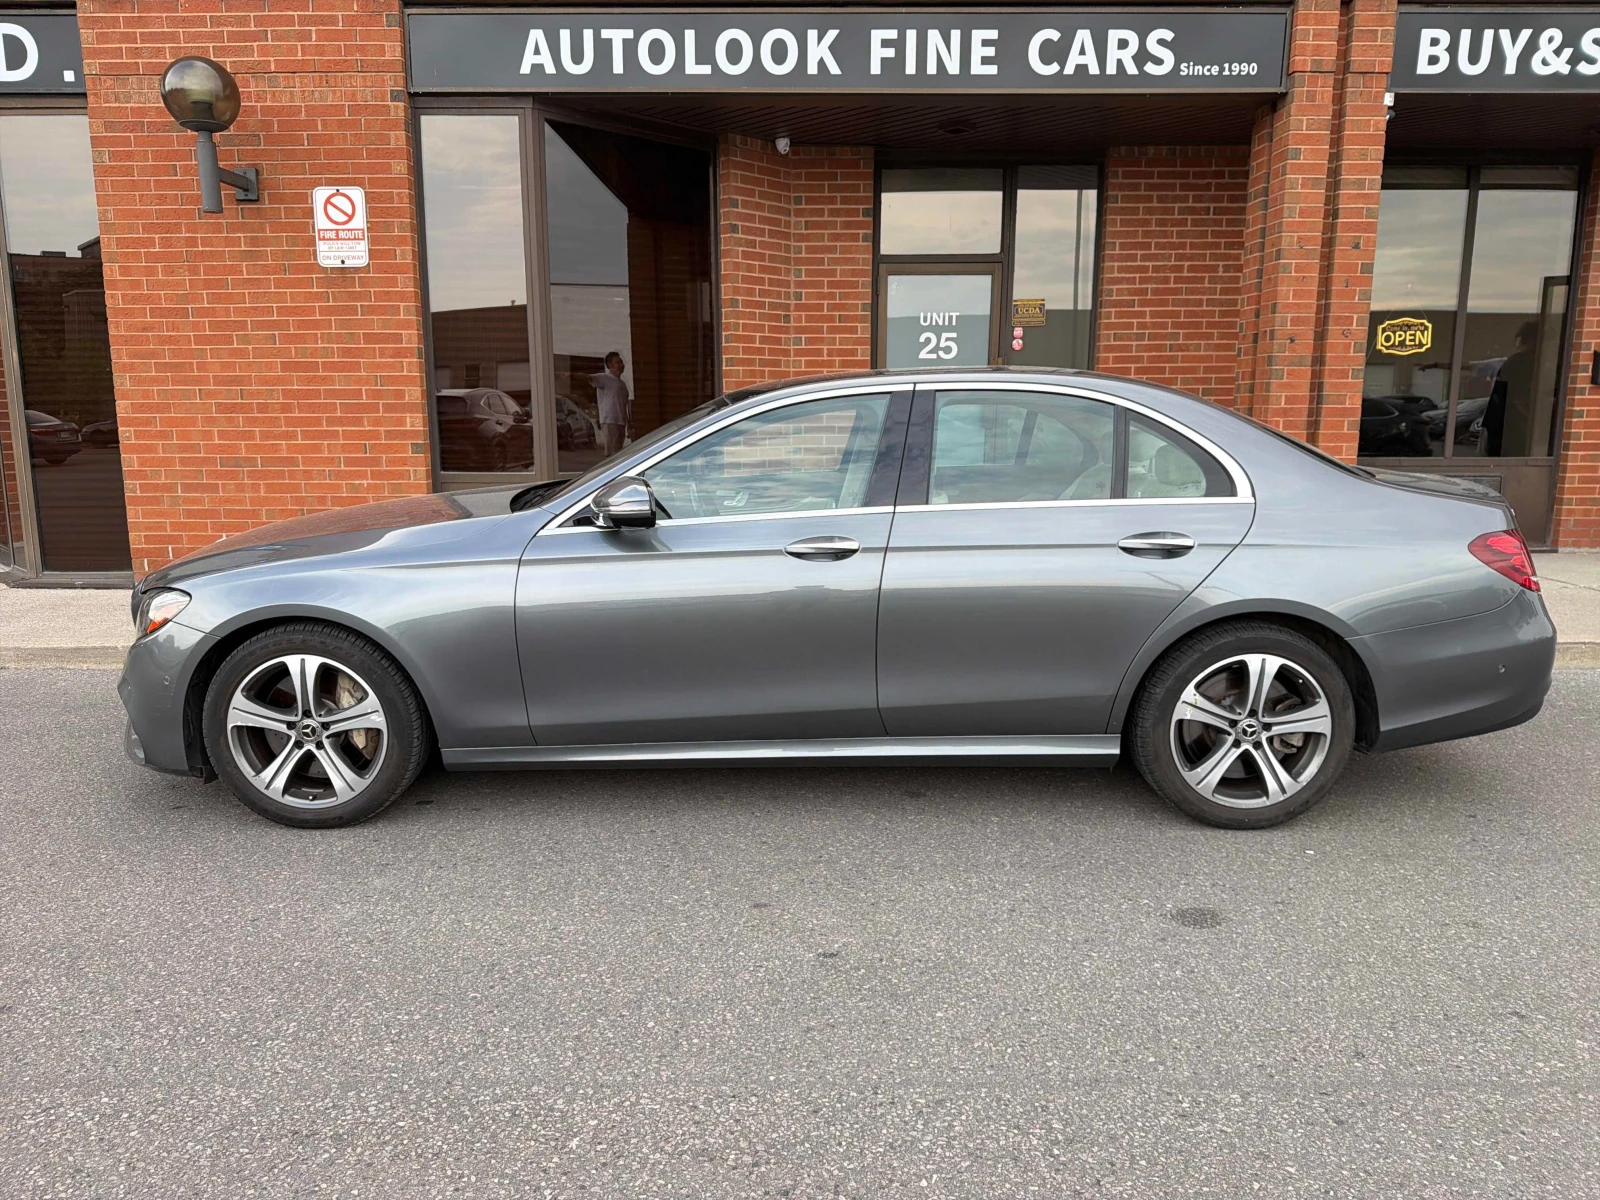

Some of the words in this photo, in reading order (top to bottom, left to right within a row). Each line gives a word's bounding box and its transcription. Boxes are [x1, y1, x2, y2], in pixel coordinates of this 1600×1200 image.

[520, 28, 842, 75] AUTOLOOK
[870, 29, 998, 75] FINE
[1028, 28, 1175, 75] CARS
[1180, 61, 1219, 76] Since
[1222, 62, 1258, 76] 1990
[320, 230, 337, 239] FIRE
[338, 230, 363, 239] ROUTE
[919, 312, 960, 326] UNIT
[918, 331, 958, 360] 25
[1381, 330, 1428, 346] OPEN
